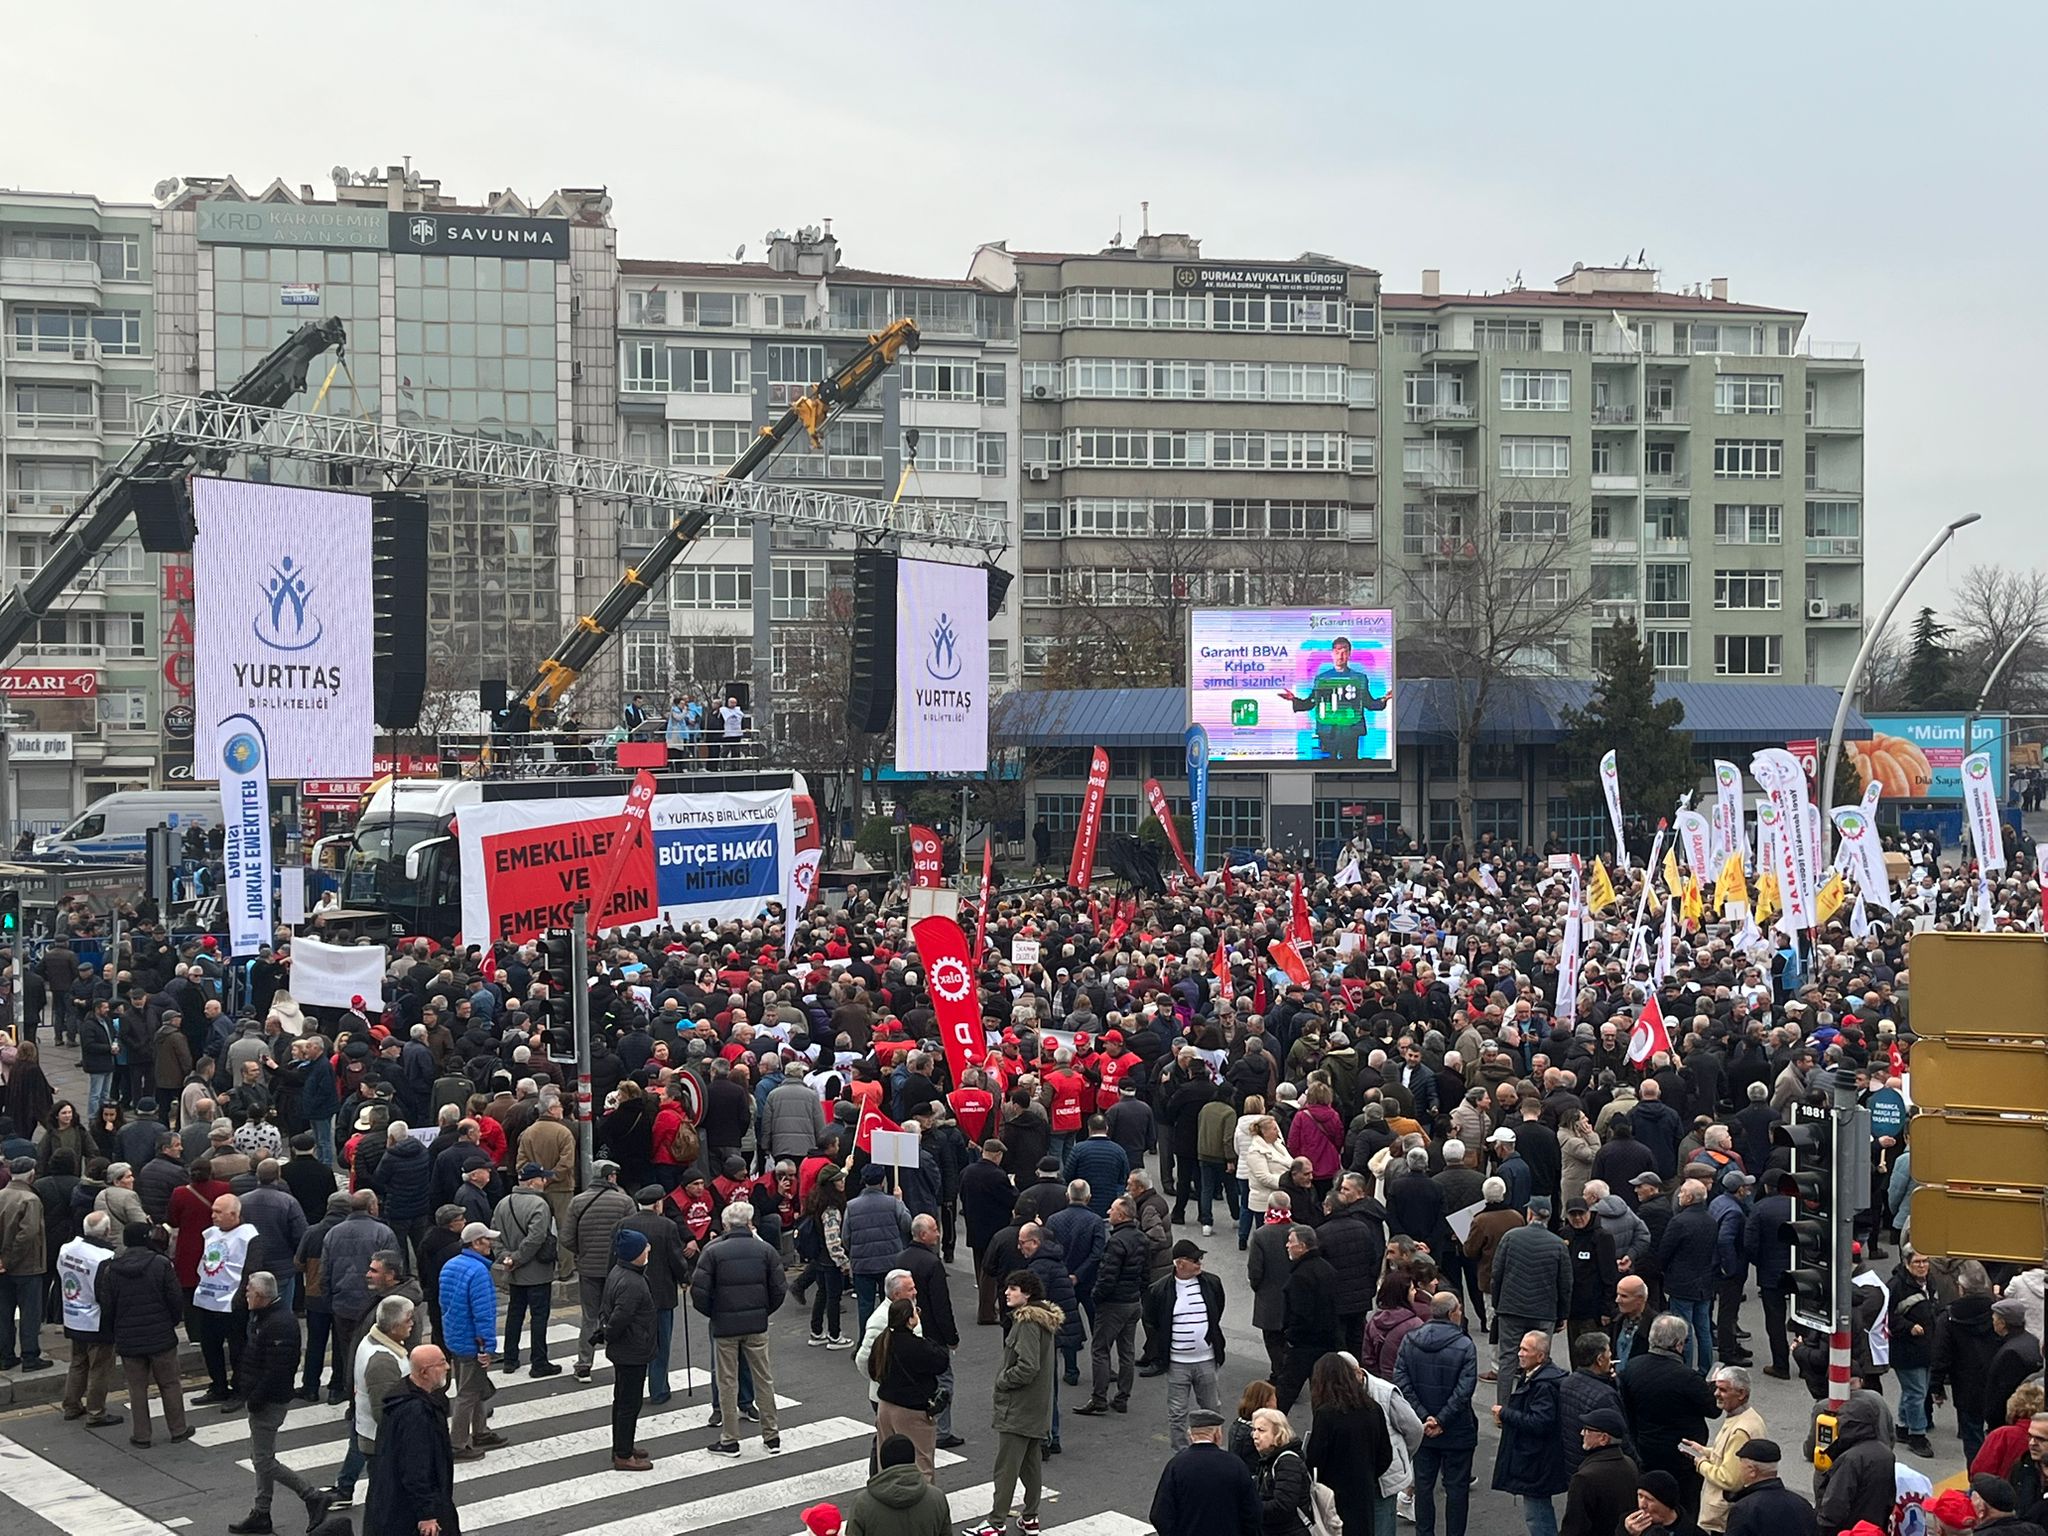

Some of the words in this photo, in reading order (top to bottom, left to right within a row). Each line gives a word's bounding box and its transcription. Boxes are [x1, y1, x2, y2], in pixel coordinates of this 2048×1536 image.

[212, 212, 263, 231] KRD
[447, 227, 553, 244] SAVUNMA
[1201, 271, 1243, 281] DURMAZ
[1245, 272, 1302, 283] AVUKATLIK
[1303, 272, 1344, 284] BÜROSU
[1200, 646, 1248, 658] Garanti
[1253, 646, 1288, 657] BBVA
[1225, 660, 1265, 674] Kripto
[233, 663, 340, 697] YURTTAŞ
[1203, 676, 1238, 688] şimdi
[916, 689, 971, 713] YURTTAŞ
[17, 739, 41, 752] black
[43, 739, 66, 753] grips
[1915, 775, 1933, 785] Dila
[669, 811, 714, 825] YURTTAŞ
[659, 841, 718, 867] BÜTÇE
[722, 839, 772, 862] HAKKI
[559, 867, 590, 892] VE
[686, 862, 750, 891] MİTİNGİ
[1801, 1105, 1825, 1119] 1881
